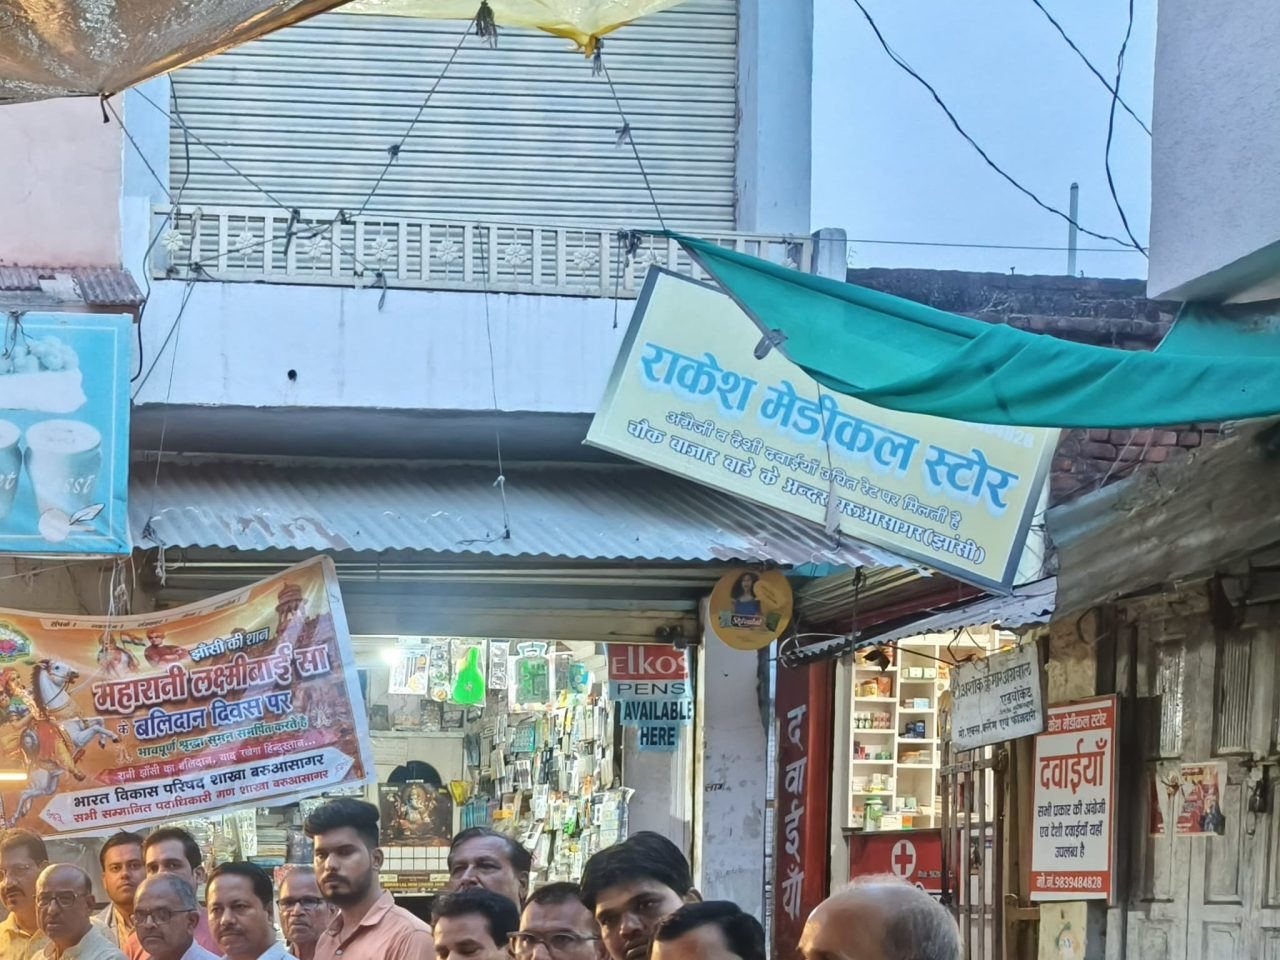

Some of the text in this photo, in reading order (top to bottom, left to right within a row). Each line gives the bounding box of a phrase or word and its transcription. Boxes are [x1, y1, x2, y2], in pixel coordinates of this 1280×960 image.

[640, 342, 1019, 509] राकेश मेडीकल स्टोर
[627, 418, 667, 445] चौक
[669, 434, 721, 465] बाजार
[759, 466, 780, 486] के
[666, 410, 962, 531] अंग्रेजी व देशी दवाईयाँ उचित रेट पर मिलती है
[226, 633, 244, 651] की
[245, 628, 270, 646] शान
[93, 644, 331, 713] महारानी लक्ष्मीबाई सा
[616, 683, 686, 695] PENS
[118, 690, 294, 741] के बलिदान दिवस पर
[623, 700, 693, 721] AVAILABLE
[207, 732, 234, 747] सुमन
[640, 726, 676, 746] HERE
[1039, 738, 1108, 795] दवाईयाँ
[73, 793, 111, 809] भारत
[113, 784, 160, 803] विकास
[163, 775, 206, 795] परिषद
[209, 769, 248, 786] शाखा
[73, 809, 98, 824] सभी
[1037, 801, 1052, 818] सभी
[1073, 799, 1083, 816] की
[1079, 841, 1085, 859] है
